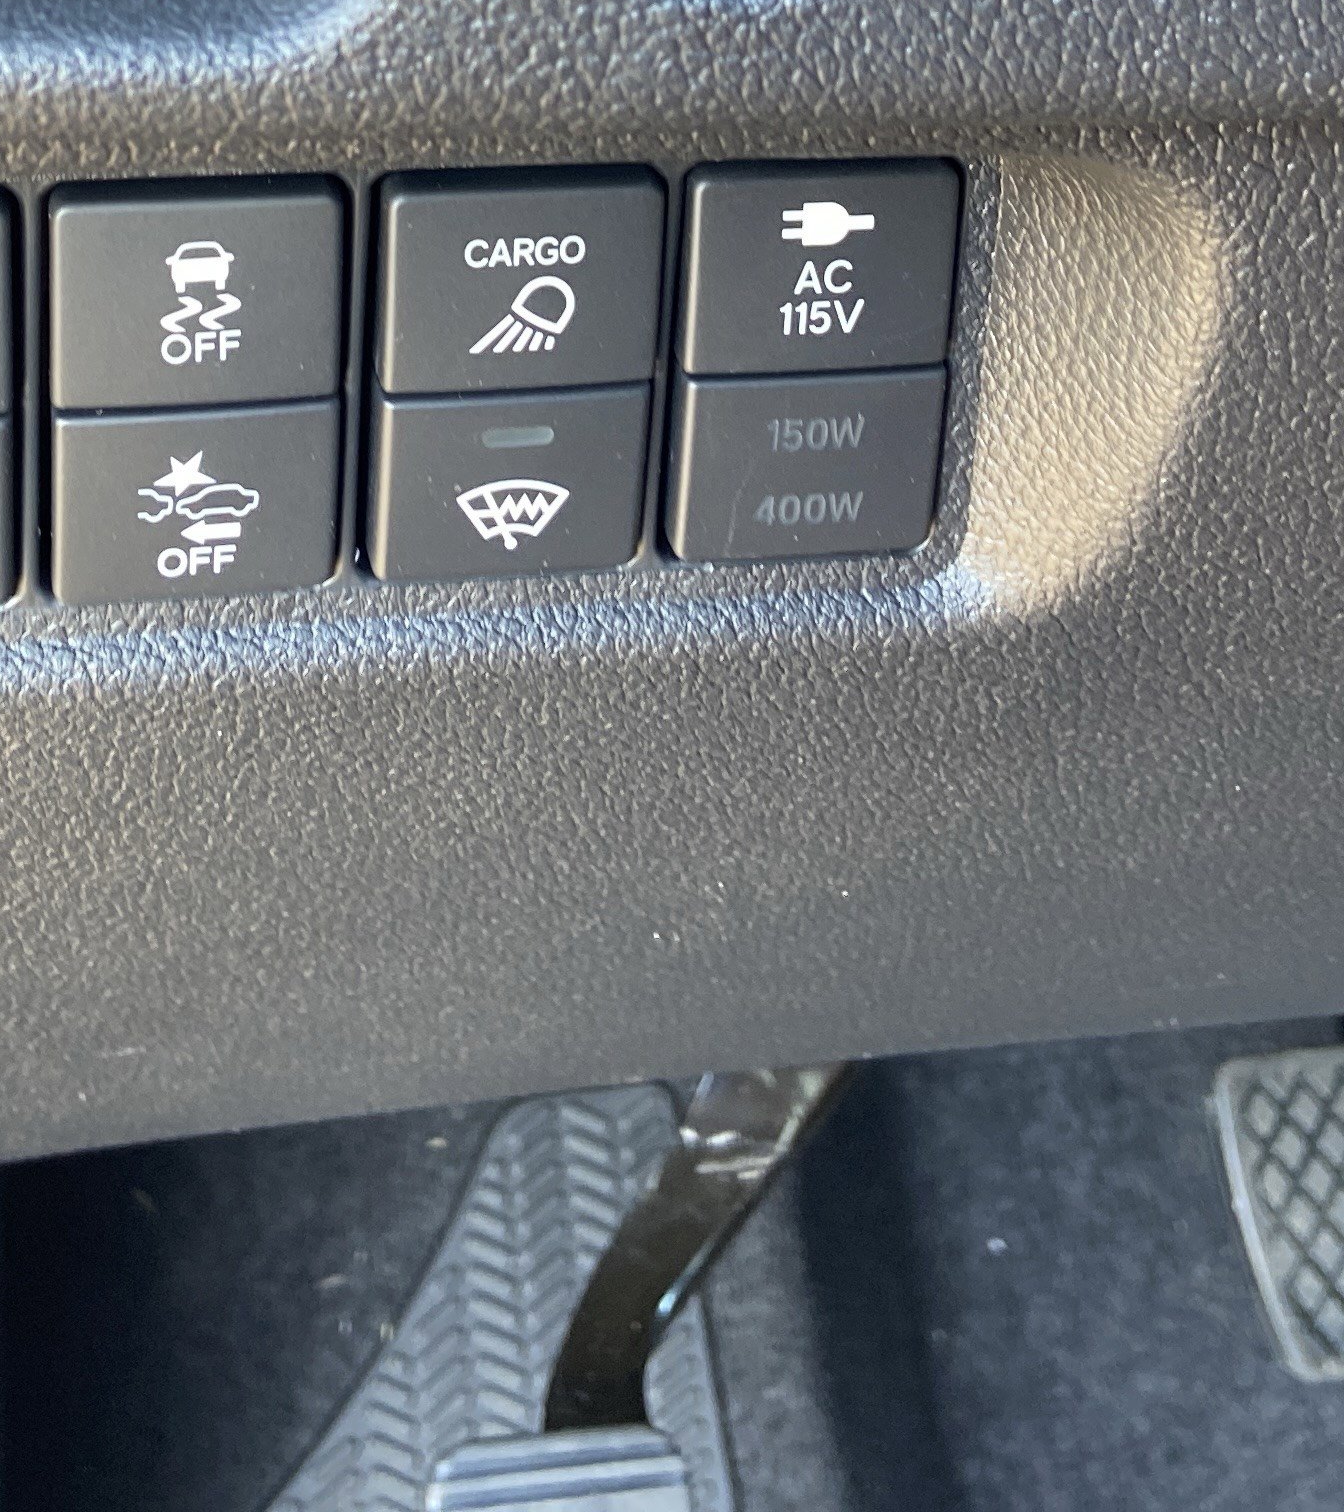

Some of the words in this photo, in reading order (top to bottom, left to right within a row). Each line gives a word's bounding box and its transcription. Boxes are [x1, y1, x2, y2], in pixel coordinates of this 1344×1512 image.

[464, 235, 586, 268] CARGO
[794, 260, 854, 296] AC
[780, 300, 865, 336] 115V
[161, 329, 242, 364] OFF
[766, 417, 866, 452] 150W
[757, 491, 863, 526] 400W
[157, 545, 236, 578] OFF
